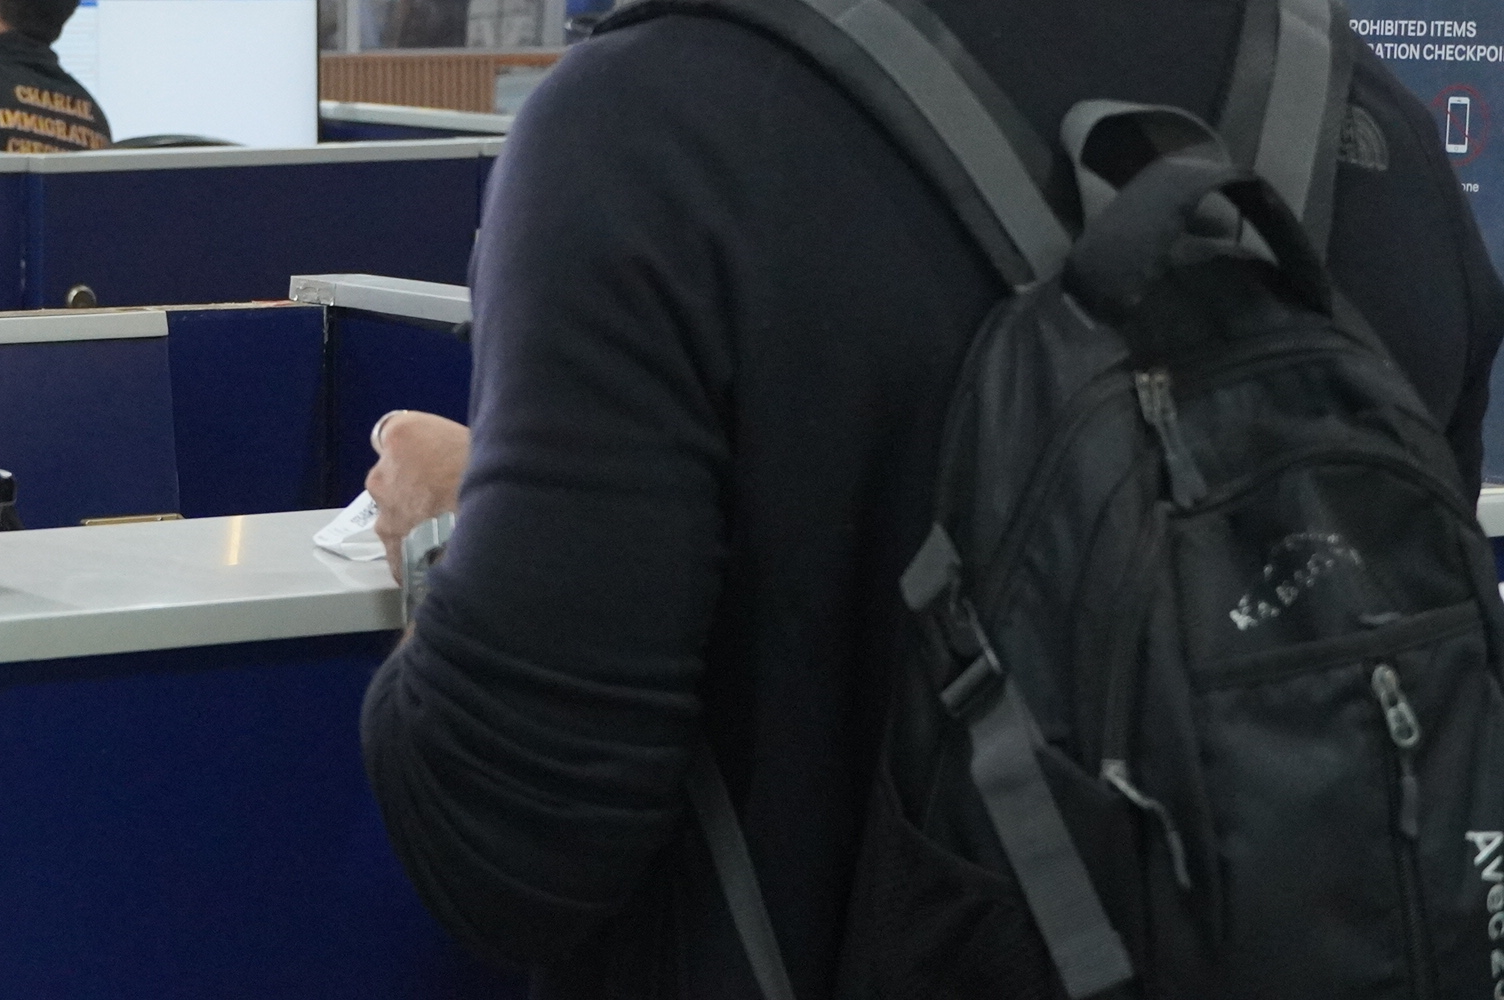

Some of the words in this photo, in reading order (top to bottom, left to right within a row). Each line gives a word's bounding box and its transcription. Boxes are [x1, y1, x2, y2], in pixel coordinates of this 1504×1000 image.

[1349, 19, 1427, 36] ROHIBITED
[1430, 20, 1477, 37] ITEMS
[1422, 44, 1504, 62] CHECKPOI
